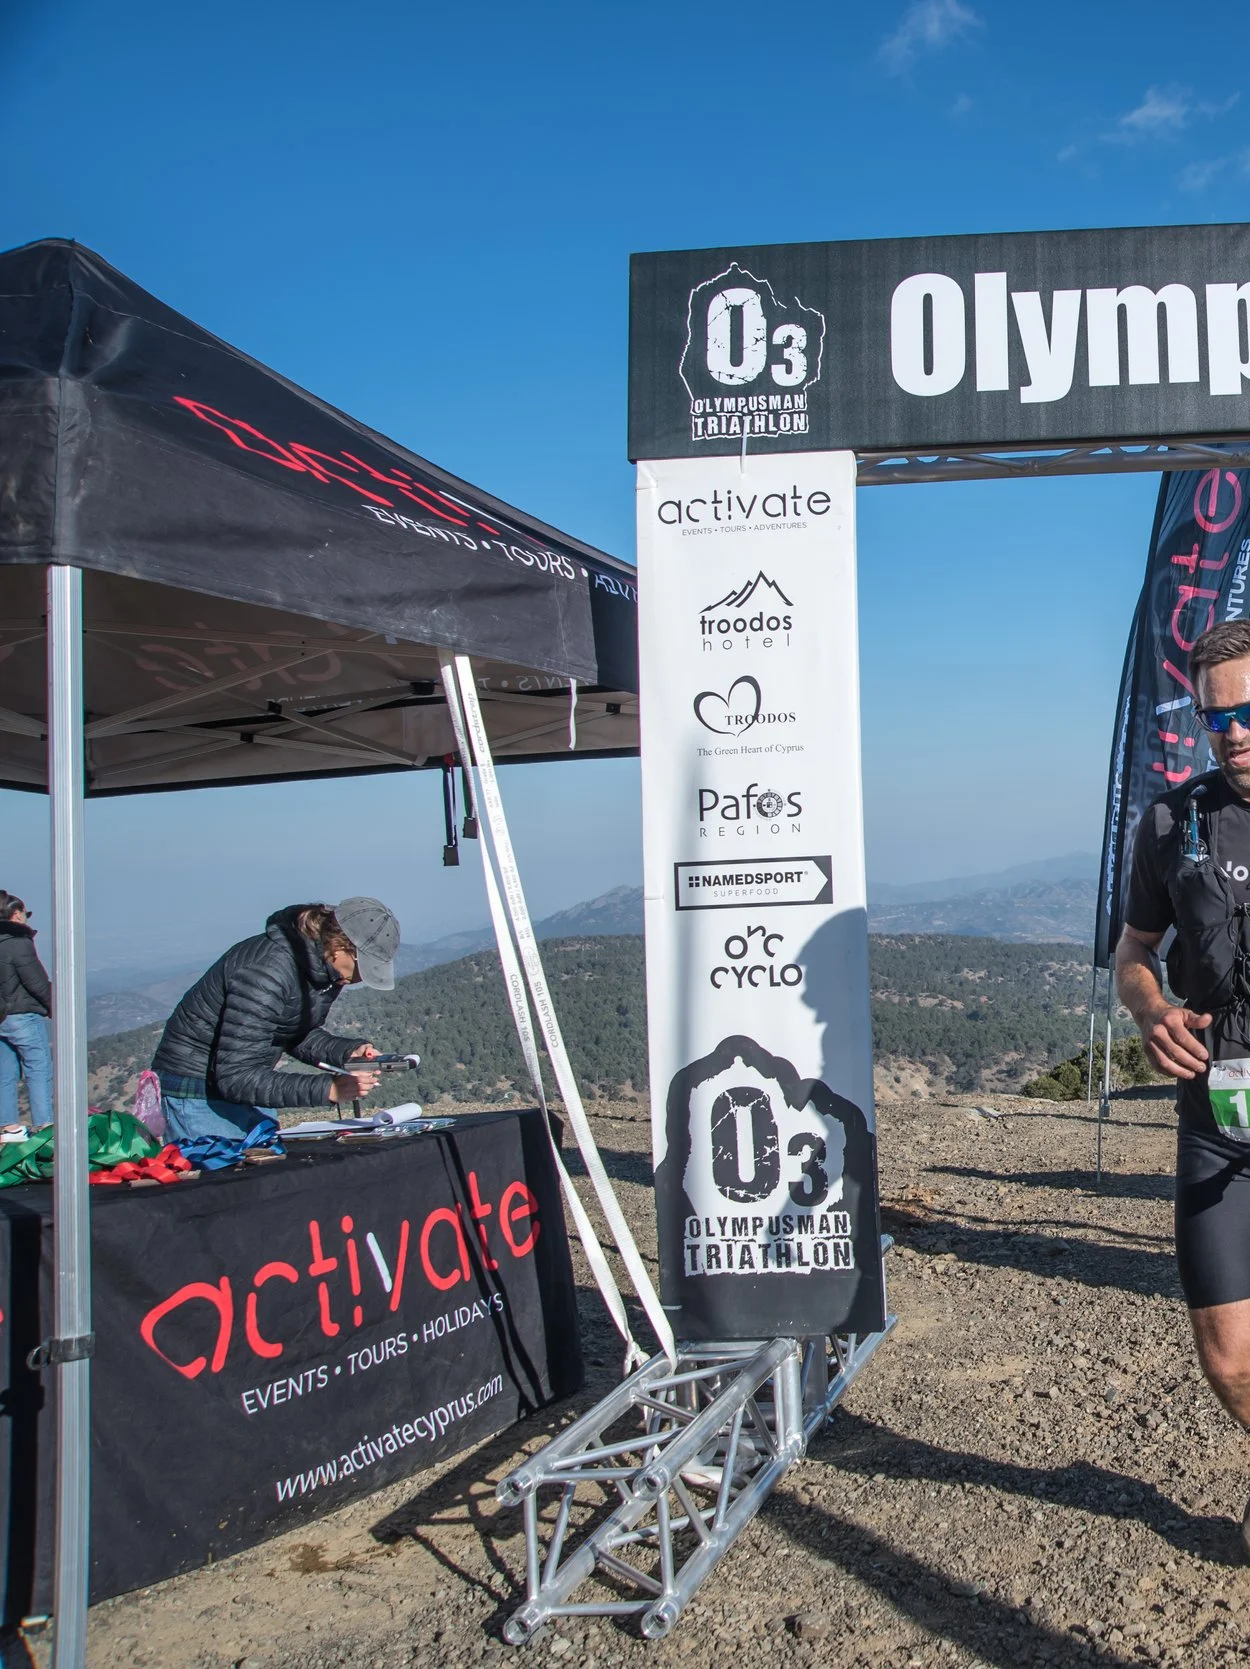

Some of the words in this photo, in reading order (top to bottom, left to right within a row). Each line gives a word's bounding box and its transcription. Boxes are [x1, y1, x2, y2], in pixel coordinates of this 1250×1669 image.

[694, 394, 805, 414] OLYMPUSMAN
[695, 414, 807, 436] TRIATHLON
[658, 485, 832, 525] activate
[682, 527, 713, 536] EVENTS
[720, 524, 747, 533] TOURS
[753, 522, 808, 532] ADVENTURES
[492, 539, 576, 580] TOURS
[700, 611, 793, 635] troodos
[702, 633, 790, 652] hotel
[724, 711, 796, 726] TROODOS
[697, 748, 713, 757] The
[714, 747, 739, 756] Green
[741, 745, 762, 755] Heart
[764, 744, 774, 753] of
[775, 743, 805, 755] Cyprus
[700, 823, 802, 838] REGION
[713, 887, 780, 898] SUPERFOOD
[710, 963, 803, 990] CYCLO
[534, 981, 545, 997] 105
[510, 974, 527, 1022] CORDLASH
[520, 1022, 531, 1042] 105
[538, 997, 559, 1048] CORDLASH
[688, 1213, 849, 1238] OLYMPUSMAN
[686, 1240, 851, 1272] TRIATHLON
[140, 1171, 541, 1381] activate
[241, 1365, 329, 1416] EVENTS
[347, 1333, 409, 1378] TOURS
[423, 1292, 505, 1345] HOLIDAYS
[275, 1373, 504, 1504] www.activatecyprus.com
